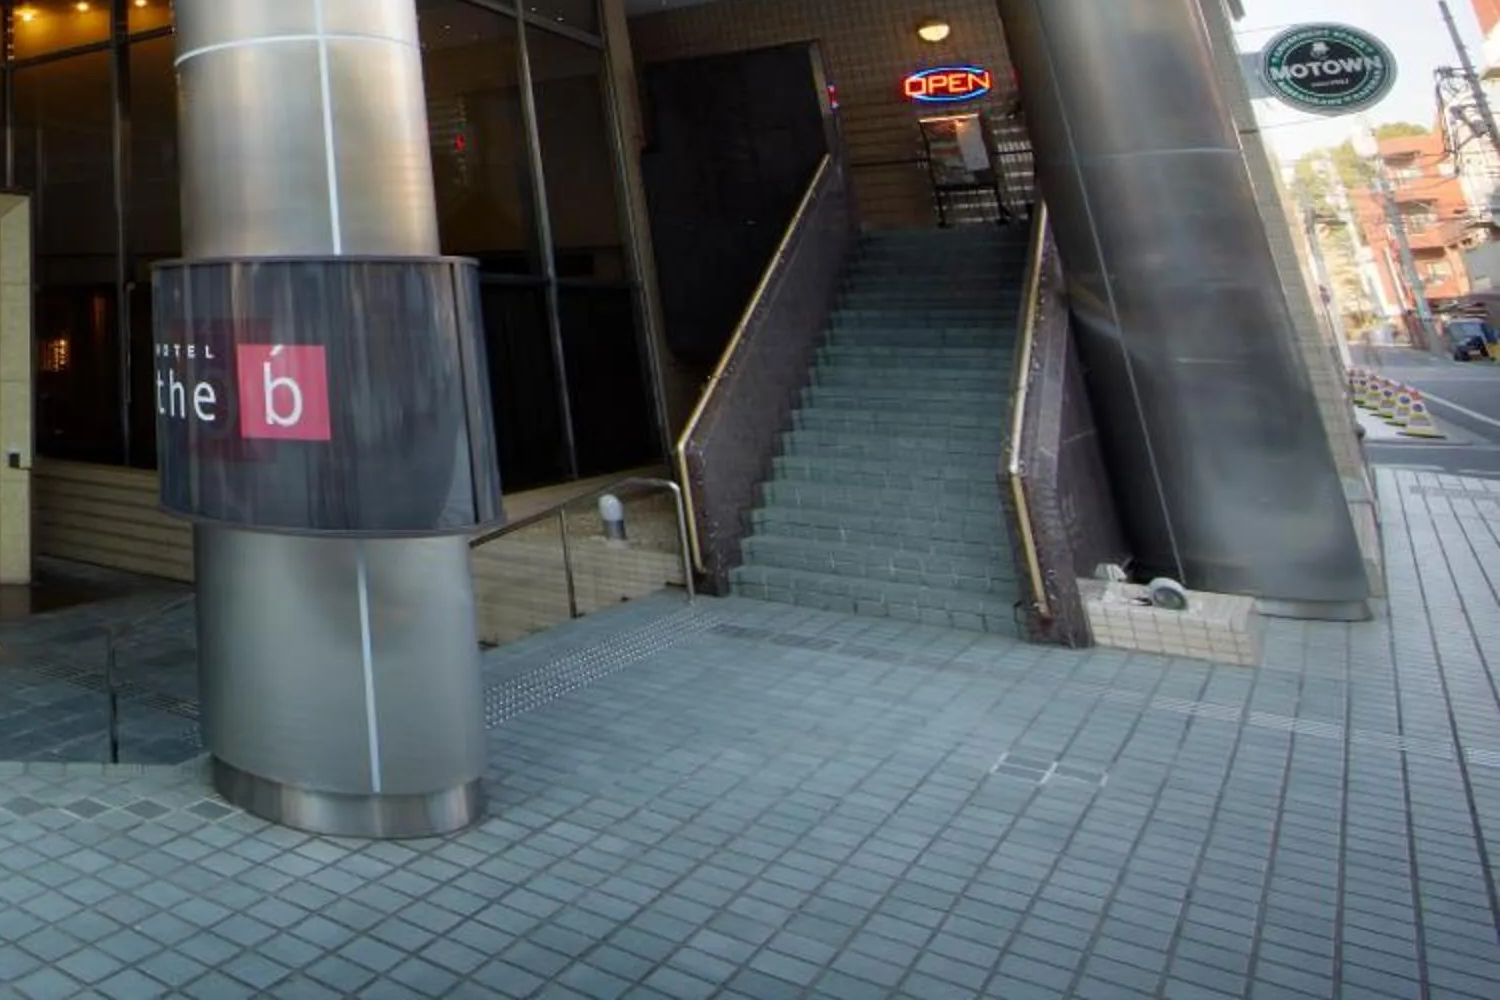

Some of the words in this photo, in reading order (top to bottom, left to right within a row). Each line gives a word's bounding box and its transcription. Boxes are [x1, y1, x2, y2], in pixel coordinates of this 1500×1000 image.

[1269, 55, 1383, 81] MOTOWN
[904, 71, 991, 96] OPEN
[156, 368, 217, 422] the
